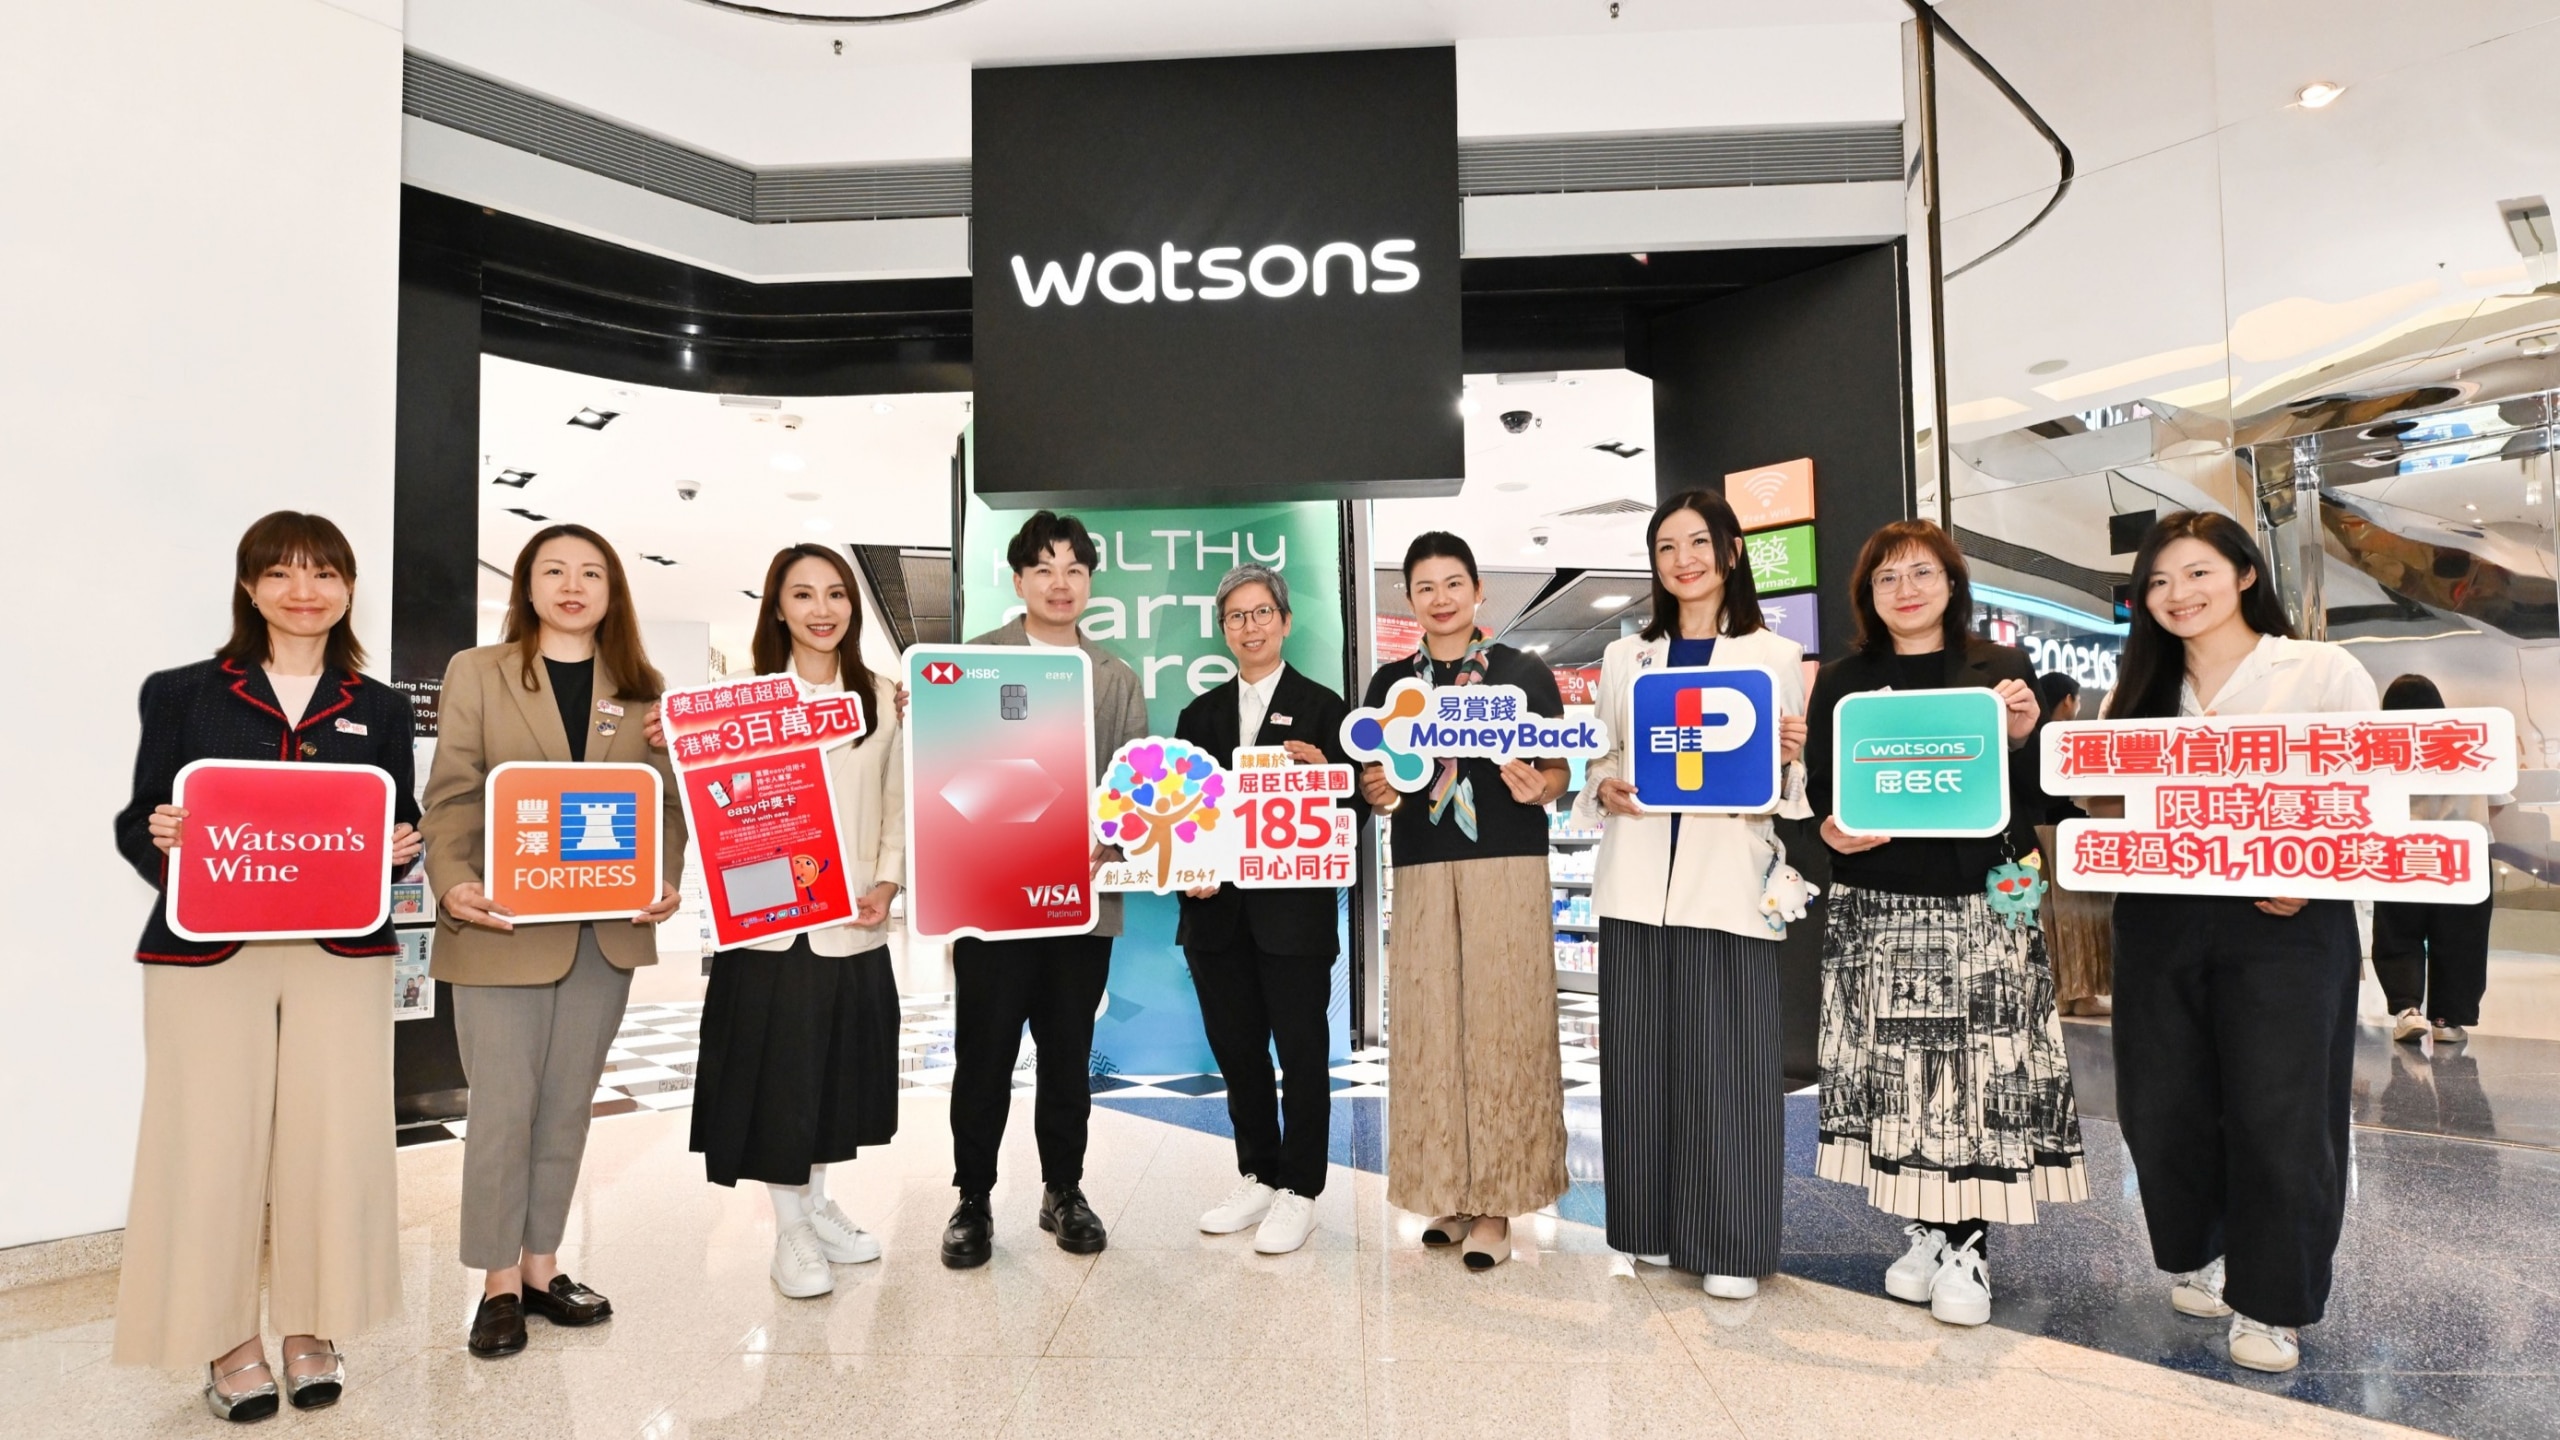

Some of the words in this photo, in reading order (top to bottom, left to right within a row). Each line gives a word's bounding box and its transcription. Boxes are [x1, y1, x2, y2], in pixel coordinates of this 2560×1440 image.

[1011, 239, 1420, 308] watsons
[1756, 577, 1798, 591] armacy
[966, 668, 1000, 680] HSBC
[1045, 672, 1074, 682] easy
[1568, 677, 1584, 690] 50
[1437, 695, 1517, 722] 易賞錢
[680, 699, 857, 758] 港幣3百萬元!
[1410, 722, 1599, 754] MoneyBack
[1649, 726, 1702, 753] 百佳
[1870, 742, 1966, 756] watsons
[1239, 770, 1349, 793] 屈臣氏集團
[1875, 769, 1963, 794] 屈臣氏
[2158, 786, 2365, 828] 限時優惠
[741, 817, 756, 825] Win
[1233, 797, 1332, 850] 185
[1334, 815, 1350, 847] 周年
[204, 822, 366, 852] Watson's
[202, 854, 299, 882] Wine
[514, 865, 637, 891] FORTRESS
[1103, 867, 1153, 886] 創立於
[1176, 869, 1216, 882] 1841
[1239, 854, 1350, 881] 同心同行
[1021, 884, 1081, 907] VISA
[1047, 910, 1082, 918] Platinum
